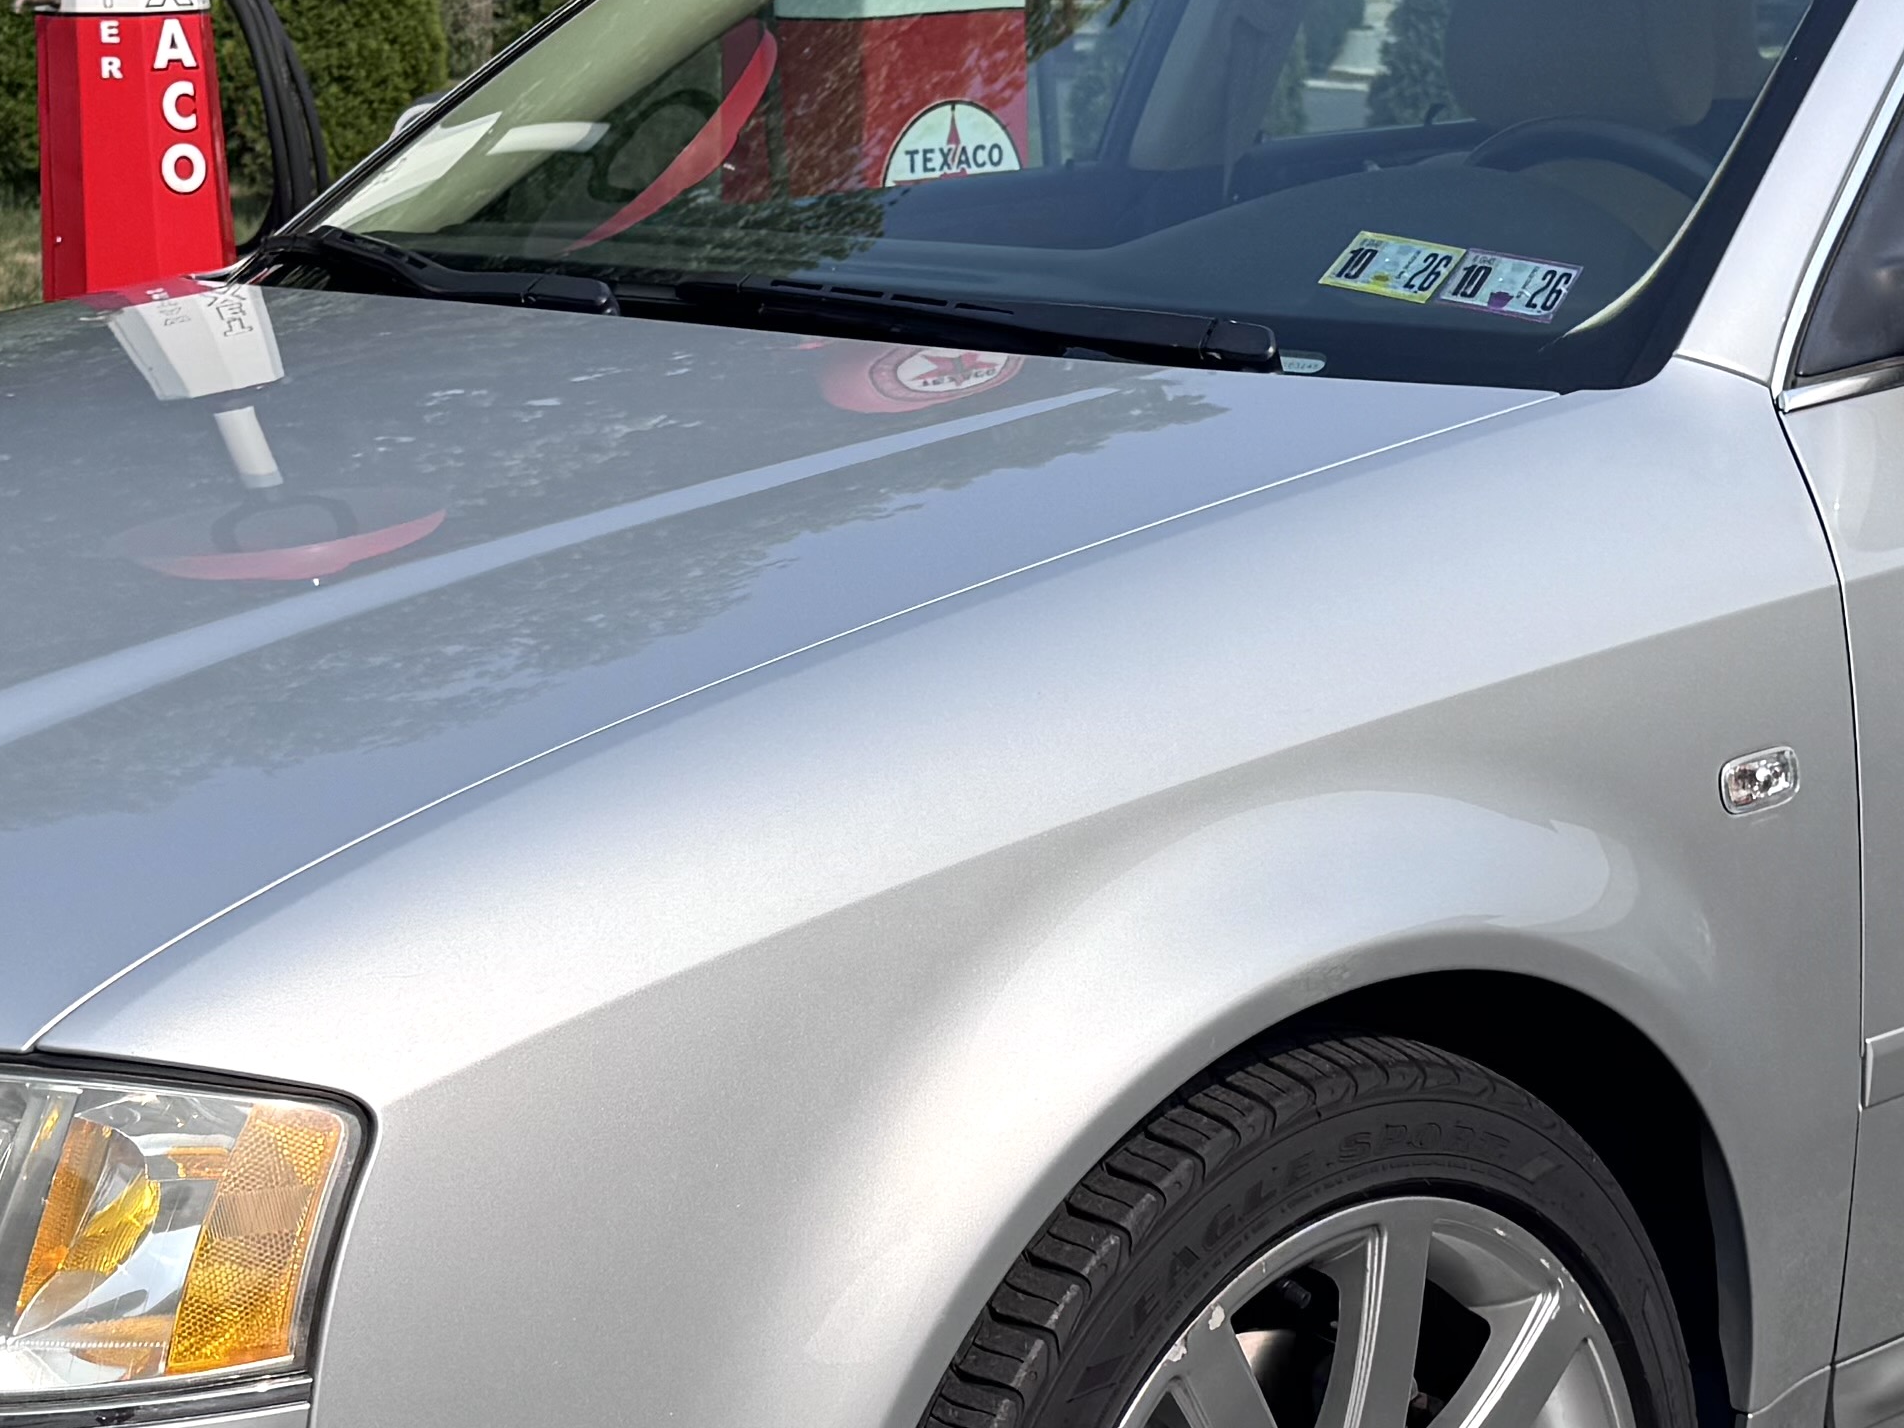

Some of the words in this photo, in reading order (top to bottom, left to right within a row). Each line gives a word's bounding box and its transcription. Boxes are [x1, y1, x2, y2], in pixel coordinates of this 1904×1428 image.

[905, 143, 1003, 174] TEXACO
[1335, 247, 1378, 279] 10
[1403, 252, 1453, 292] 26
[1451, 264, 1492, 298] 10
[1525, 269, 1573, 311] 26
[1130, 1150, 1314, 1340] EAGLE
[1338, 1121, 1512, 1164] SPORT
